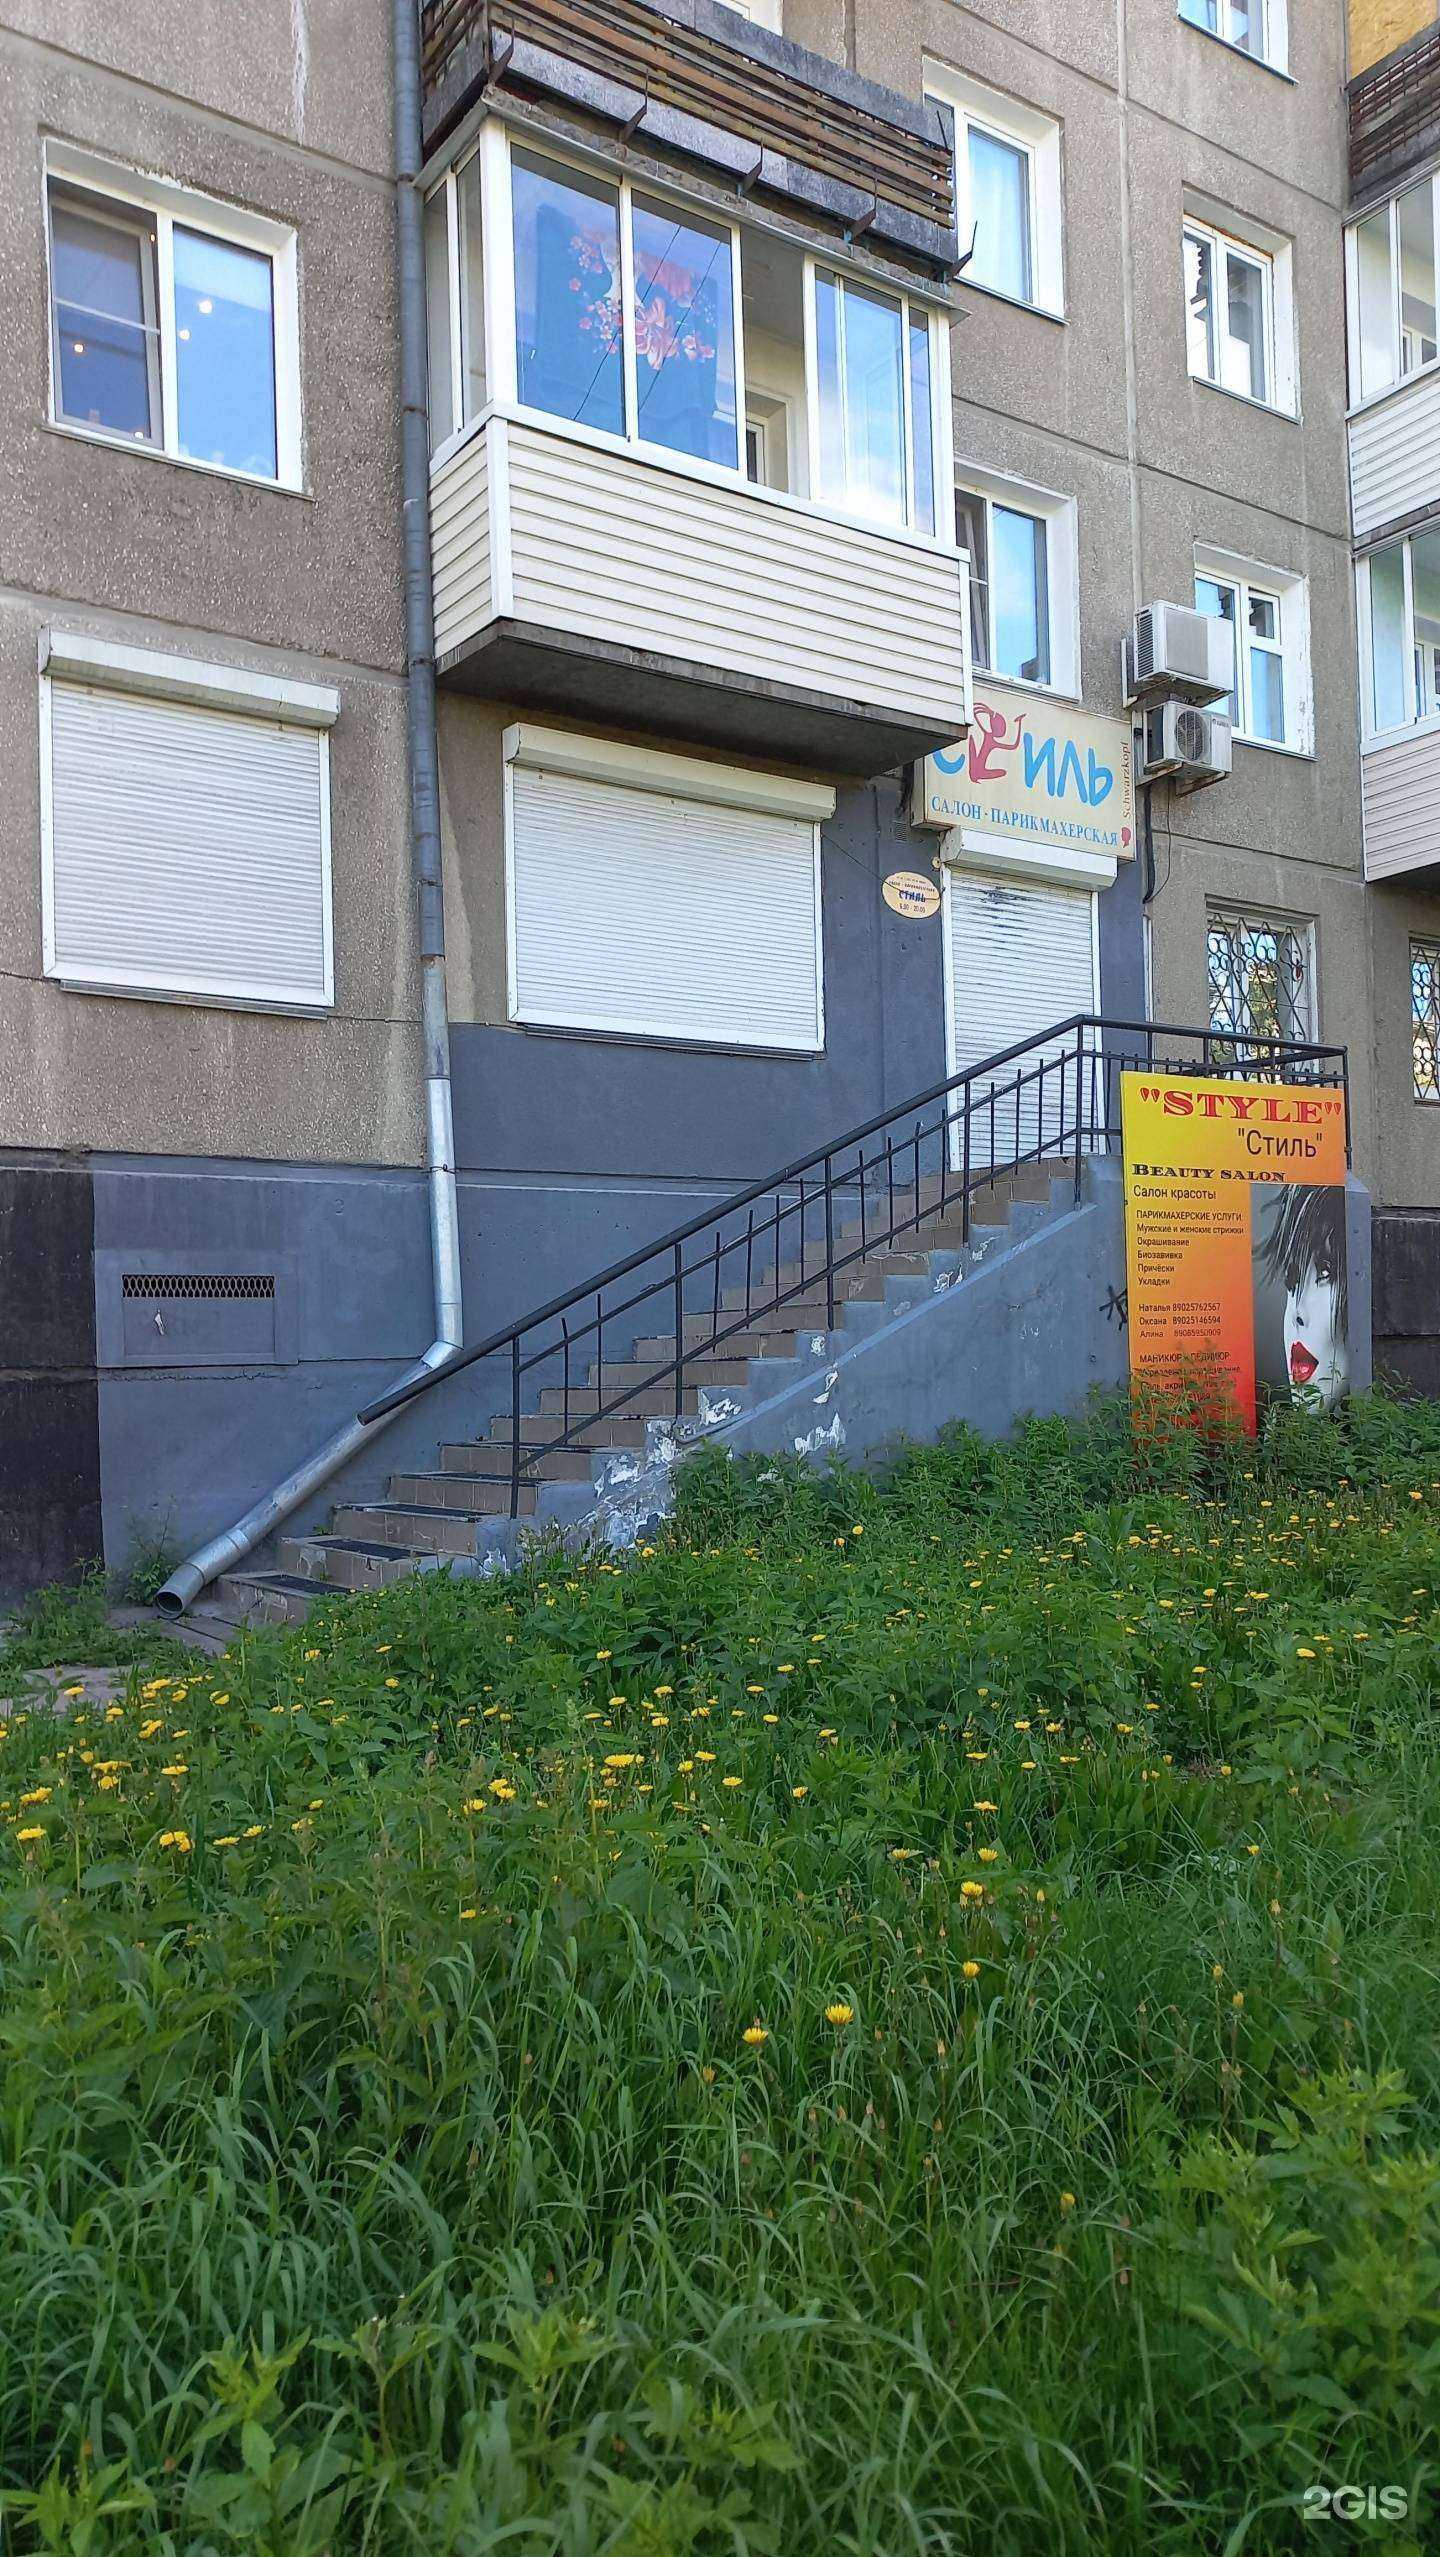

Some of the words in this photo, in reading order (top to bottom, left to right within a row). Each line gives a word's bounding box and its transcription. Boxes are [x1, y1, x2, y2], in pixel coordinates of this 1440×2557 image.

[931, 796, 981, 820] САЛОН
[991, 807, 1118, 847] ПАРИКМАХЕРСКАЯ
[1139, 1087, 1342, 1125] "STYLE"
[1237, 1127, 1323, 1158] "Стиль"
[1132, 1163, 1215, 1179] BEAUTY
[1220, 1169, 1286, 1182] SALON
[1133, 1184, 1168, 1198] Салон
[1171, 1188, 1217, 1201] красоты
[1136, 1209, 1210, 1221] ПАРИКМАХЕРСКИЕ
[1212, 1212, 1242, 1221] УСЛУГИ
[1137, 1223, 1172, 1234] Мужские
[1213, 1227, 1244, 1236] стрижки
[1137, 1237, 1190, 1247] Окрашивание
[1137, 1250, 1183, 1260] Биозавивка
[1138, 1276, 1171, 1287] Укладки
[1138, 1303, 1171, 1312] Наталья
[1139, 1317, 1168, 1326] Оксана
[1140, 1330, 1164, 1338] Алина
